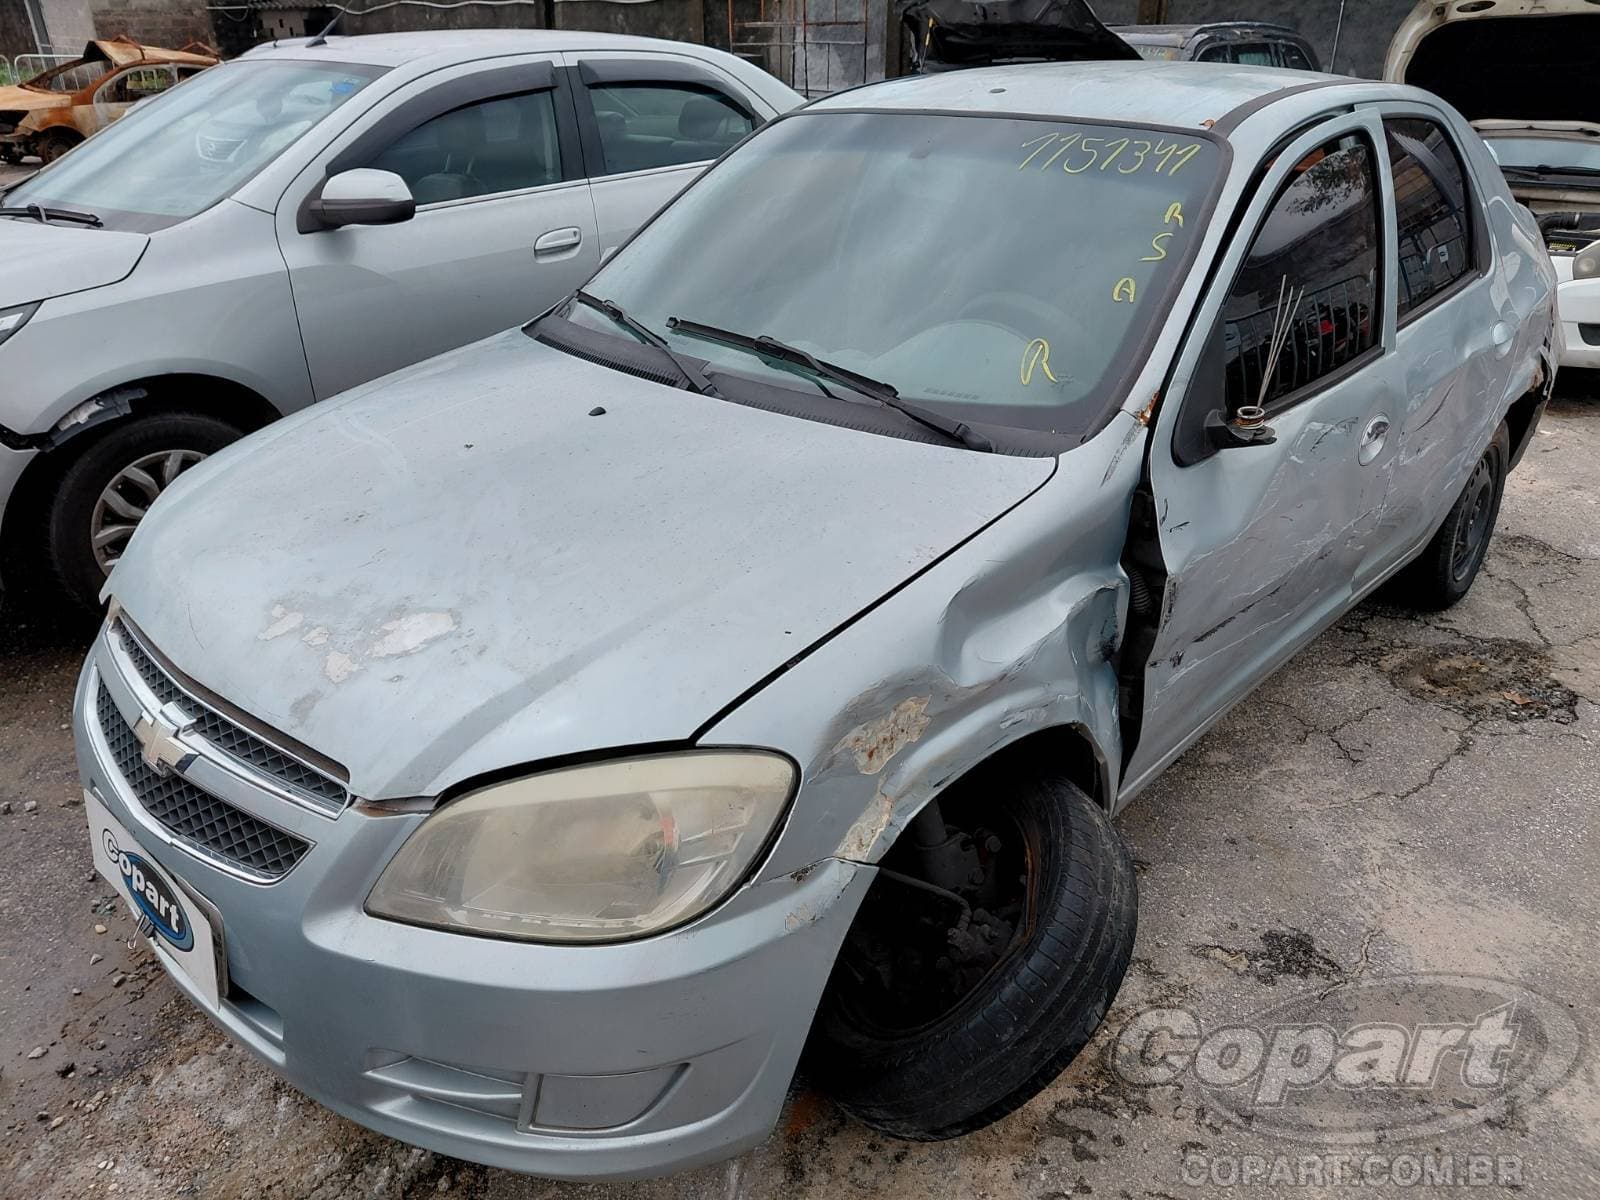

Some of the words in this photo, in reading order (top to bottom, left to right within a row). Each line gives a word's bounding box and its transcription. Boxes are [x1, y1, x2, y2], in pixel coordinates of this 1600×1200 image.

[1018, 132, 1202, 177] 1151341
[1137, 232, 1174, 262] S
[1112, 277, 1137, 303] A
[102, 828, 181, 934] Copart
